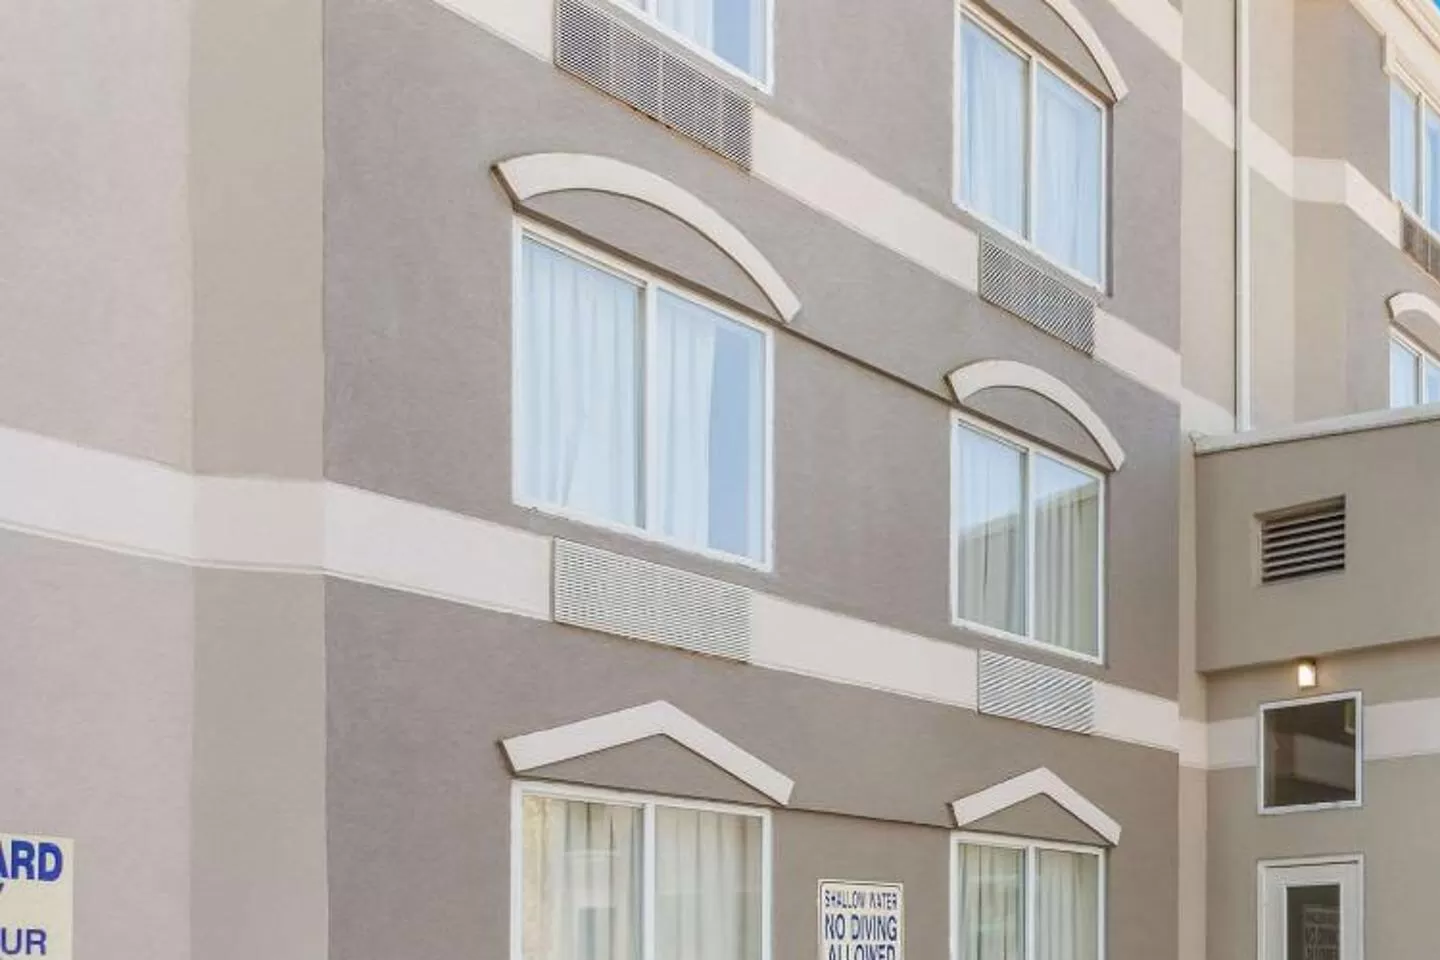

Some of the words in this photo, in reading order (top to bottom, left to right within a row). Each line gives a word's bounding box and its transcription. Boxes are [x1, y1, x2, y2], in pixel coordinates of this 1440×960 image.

[825, 890, 866, 908] SHALLOW
[869, 892, 897, 909] WATER
[825, 913, 845, 940] NO
[851, 914, 897, 941] DIVING
